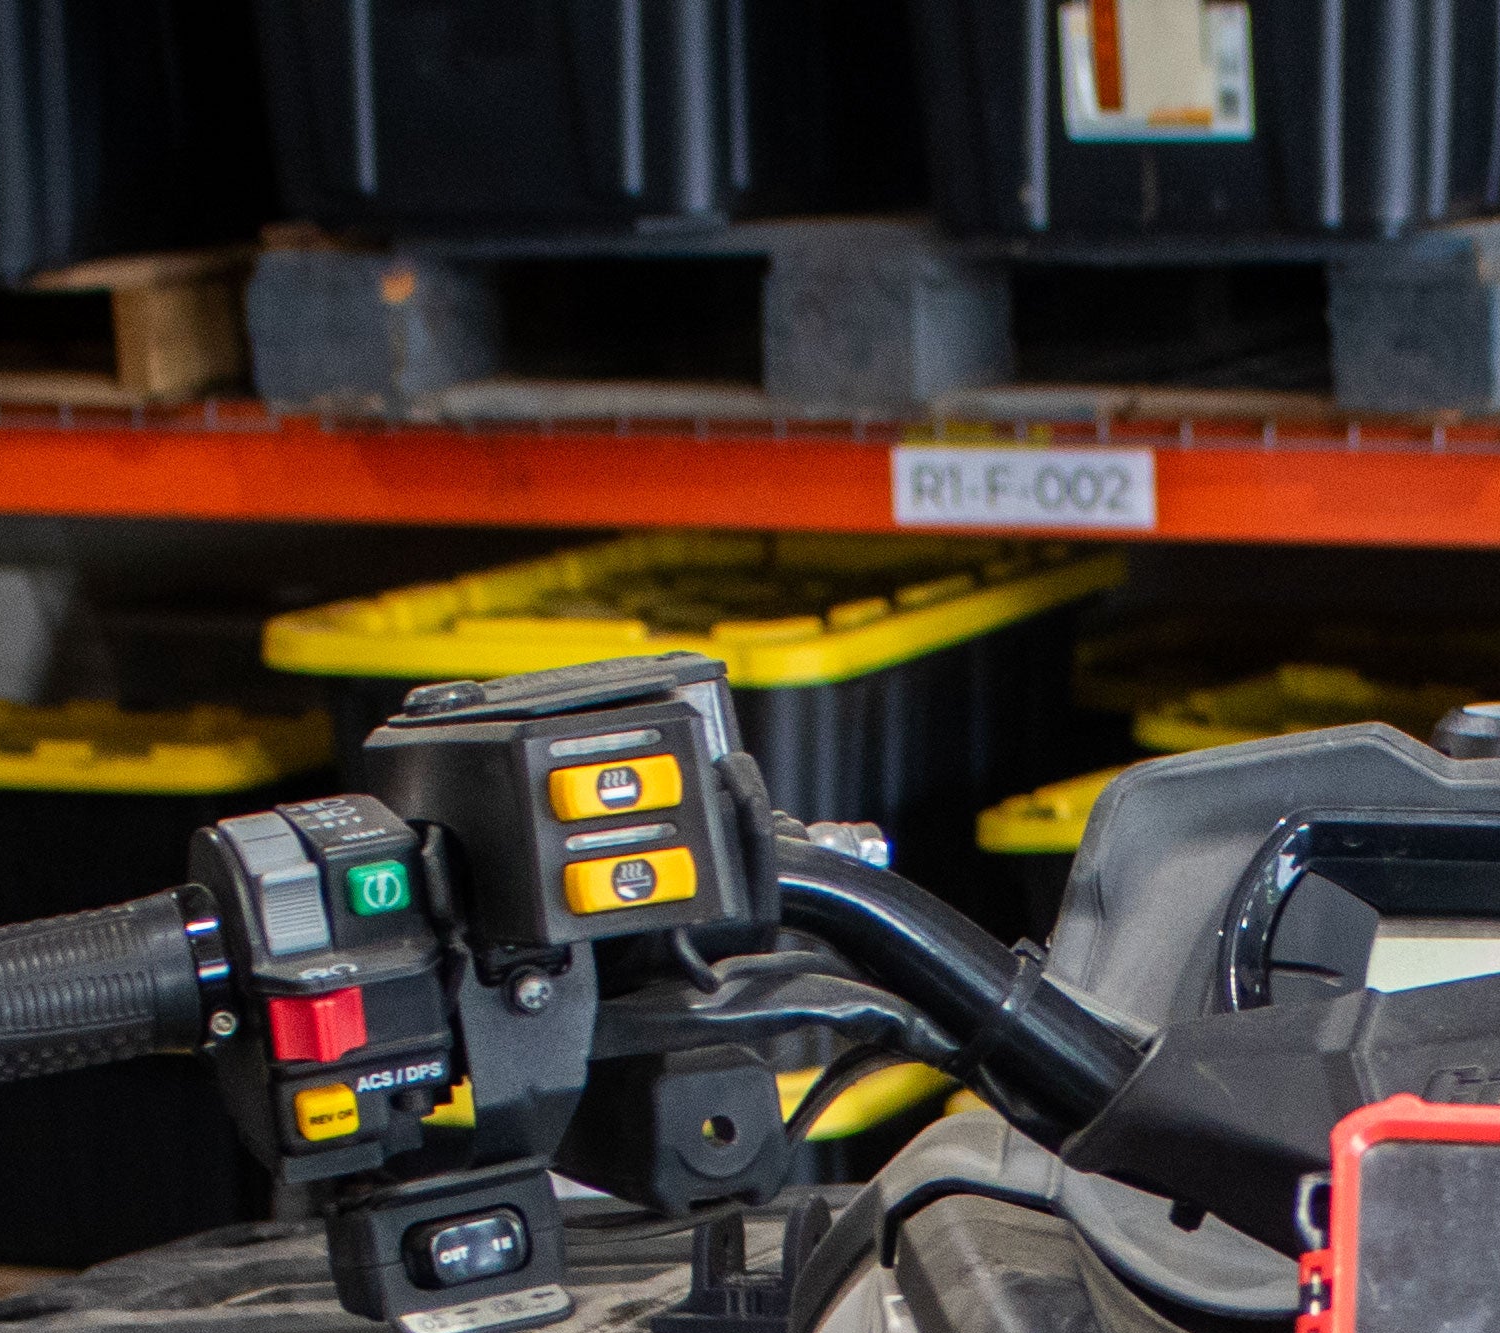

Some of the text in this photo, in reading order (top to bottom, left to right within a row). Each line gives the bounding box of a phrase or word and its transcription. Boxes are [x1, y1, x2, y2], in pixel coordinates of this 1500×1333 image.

[909, 463, 1132, 512] R1-F-002
[356, 1070, 394, 1093] ACS
[405, 1060, 444, 1083] DPS
[439, 1245, 469, 1264] OUT
